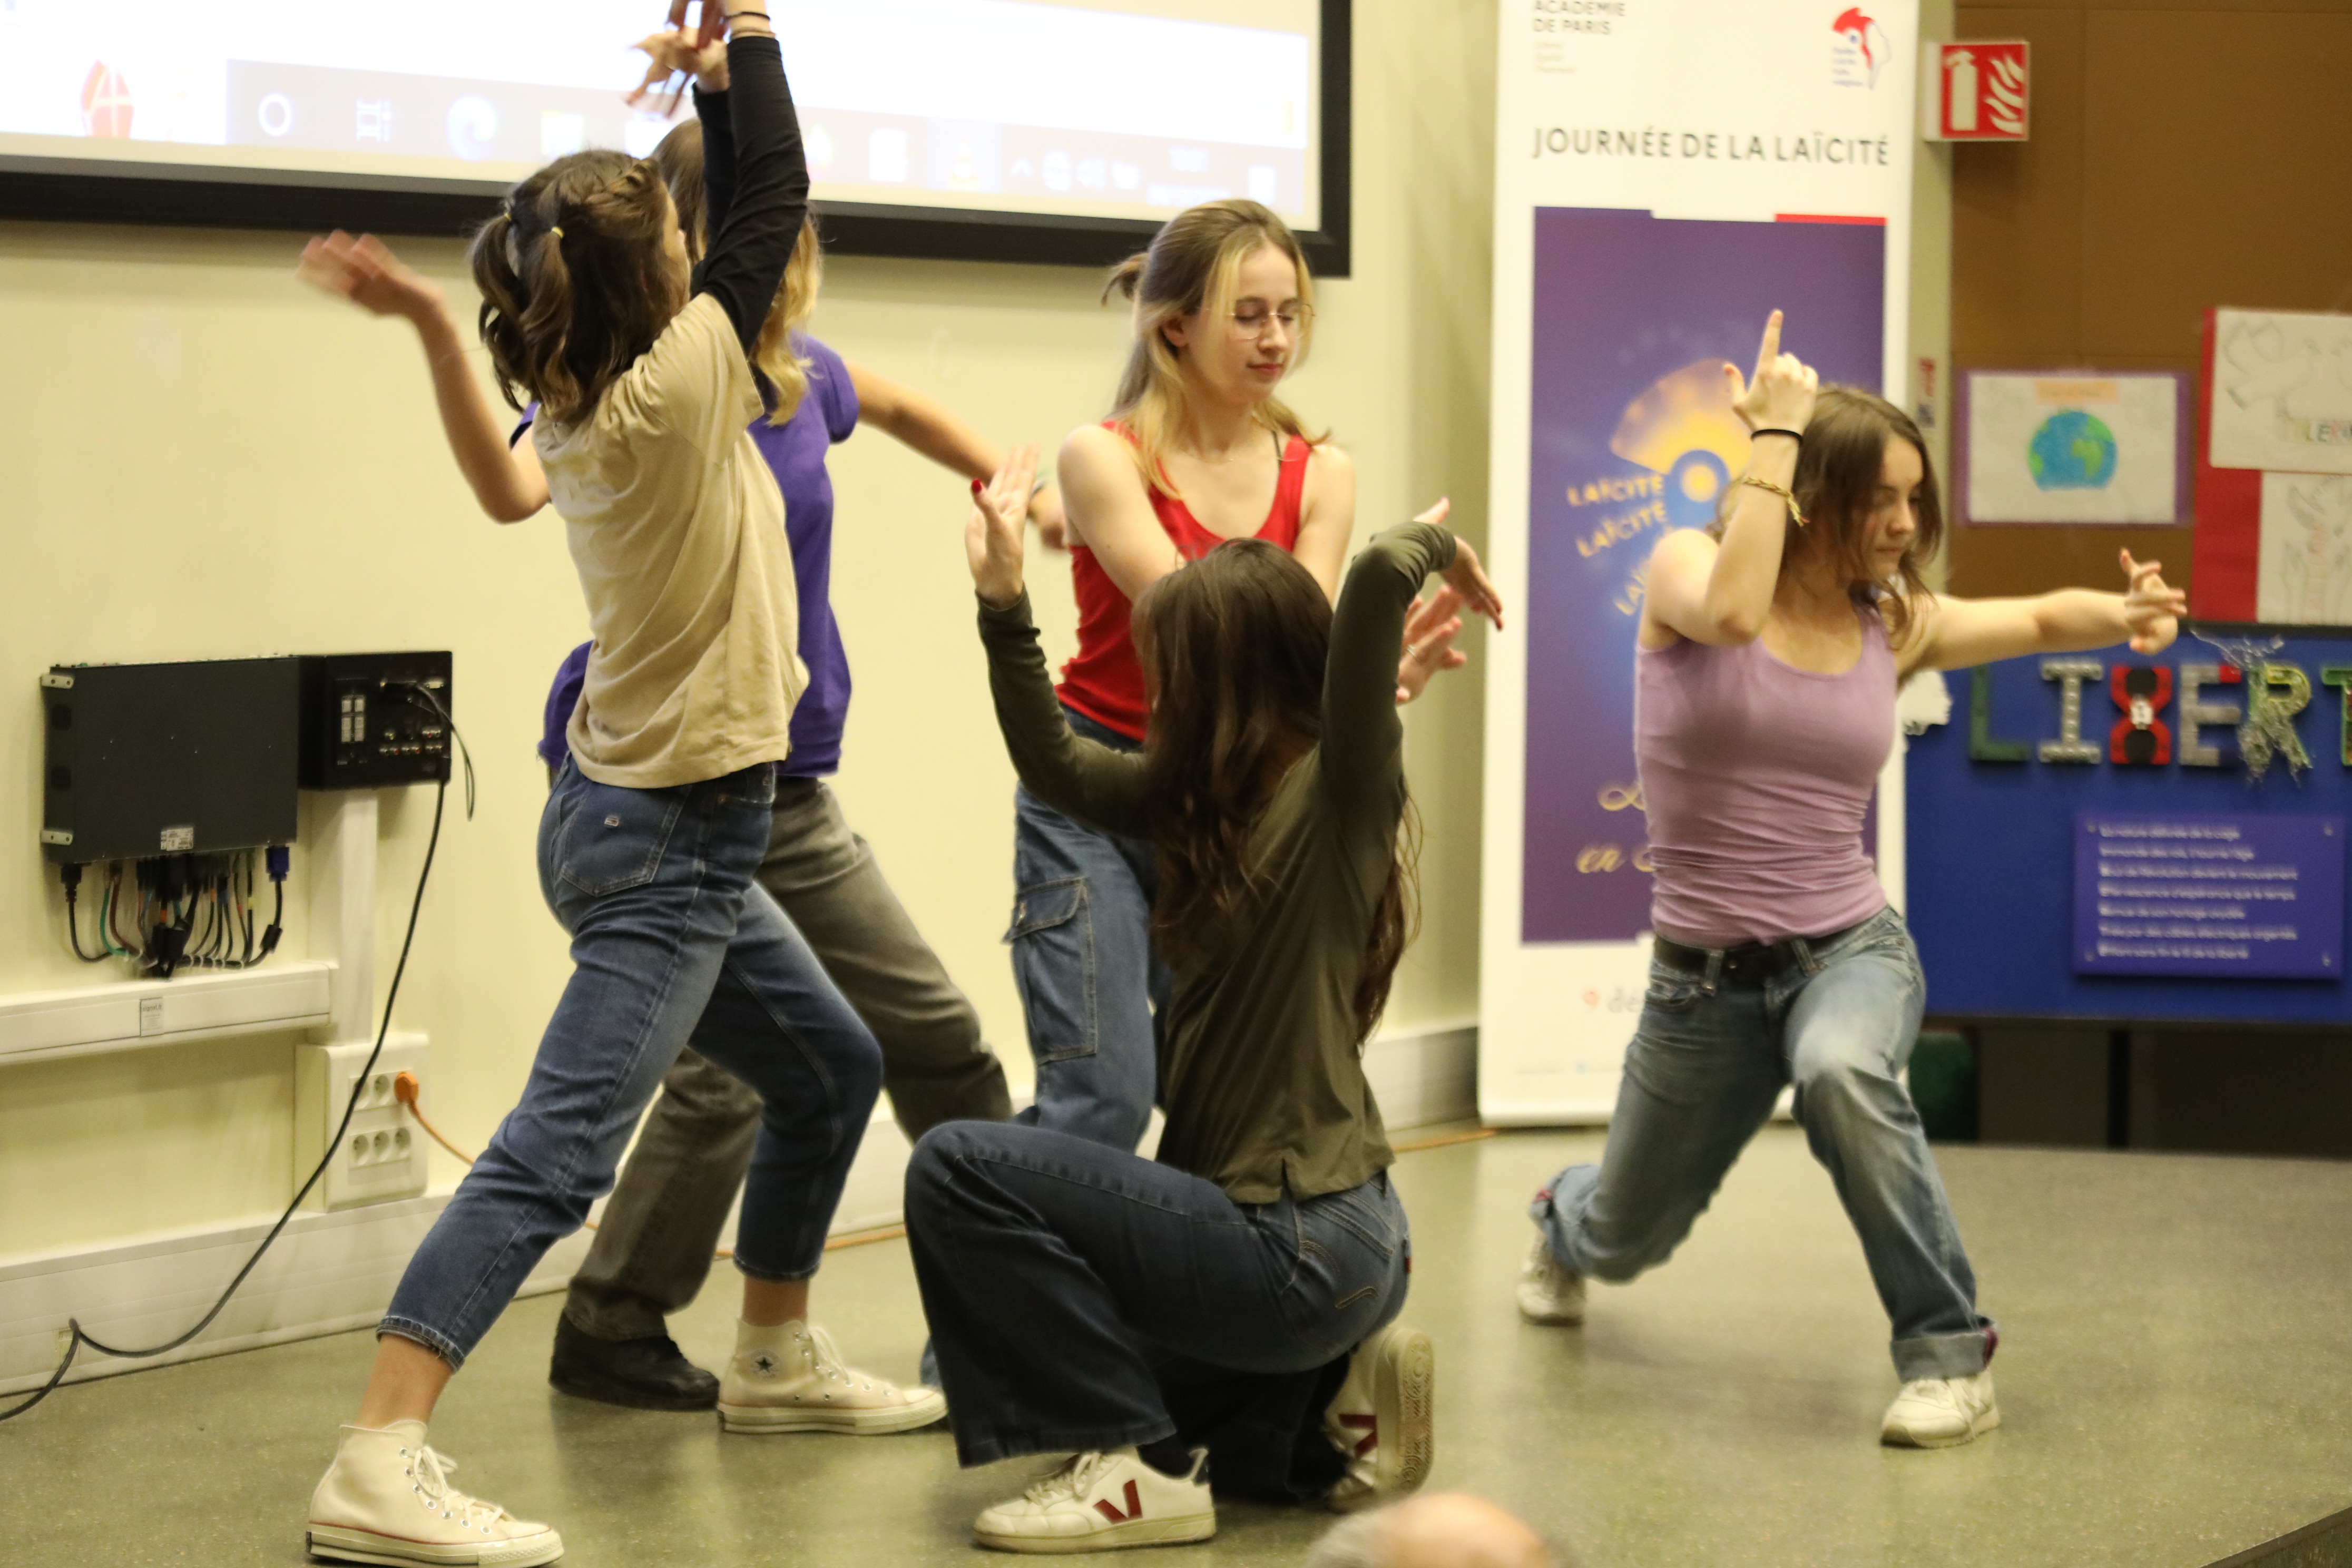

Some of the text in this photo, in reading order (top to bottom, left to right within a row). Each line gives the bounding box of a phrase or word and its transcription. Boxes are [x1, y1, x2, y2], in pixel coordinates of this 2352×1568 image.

[1534, 19, 1610, 35] DE PARIS
[1531, 125, 1889, 165] JOURNÉE DE LA LAÏCITÉ
